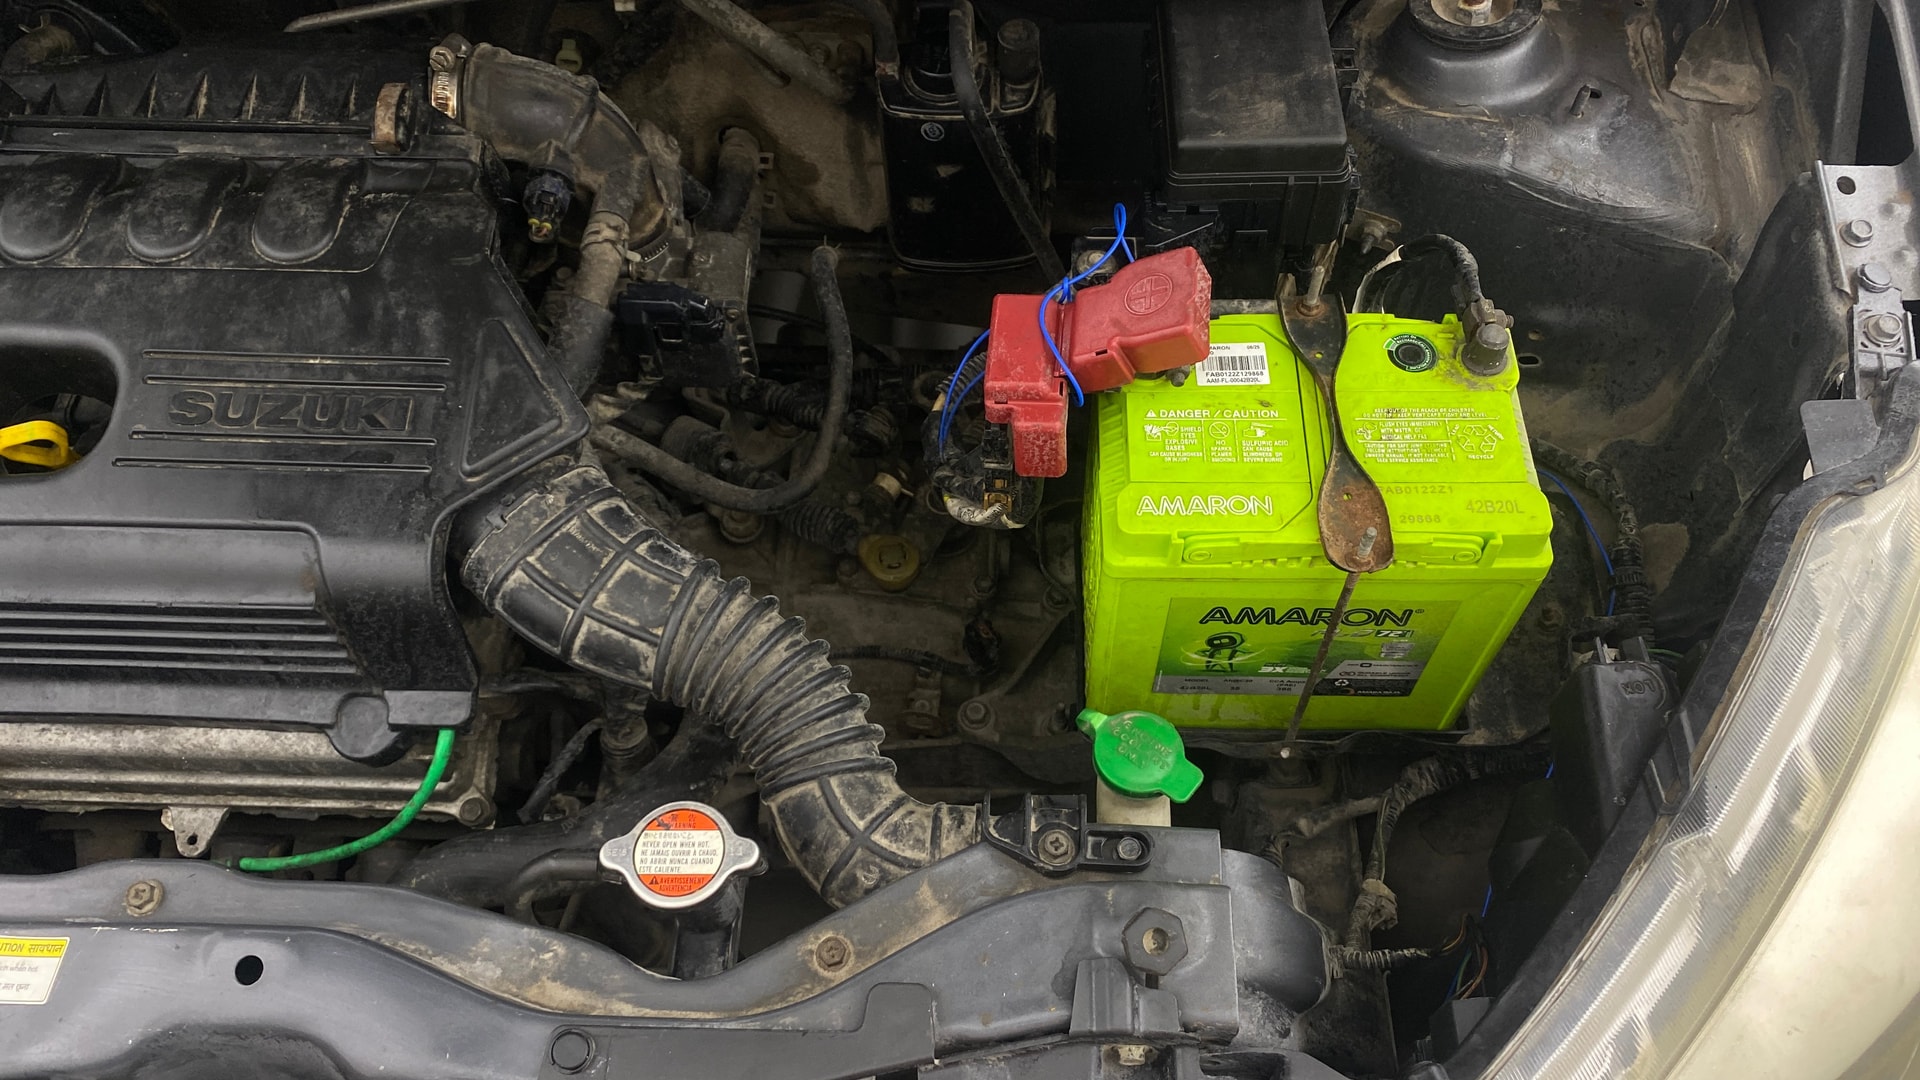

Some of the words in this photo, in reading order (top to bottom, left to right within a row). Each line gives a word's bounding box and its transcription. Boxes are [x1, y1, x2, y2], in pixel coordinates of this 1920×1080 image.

[168, 390, 413, 431] SUZUKI
[1223, 410, 1279, 418] CAUTION
[1136, 495, 1273, 516] AMARON
[1466, 500, 1526, 514] 42B20L
[1199, 606, 1414, 627] AMARON
